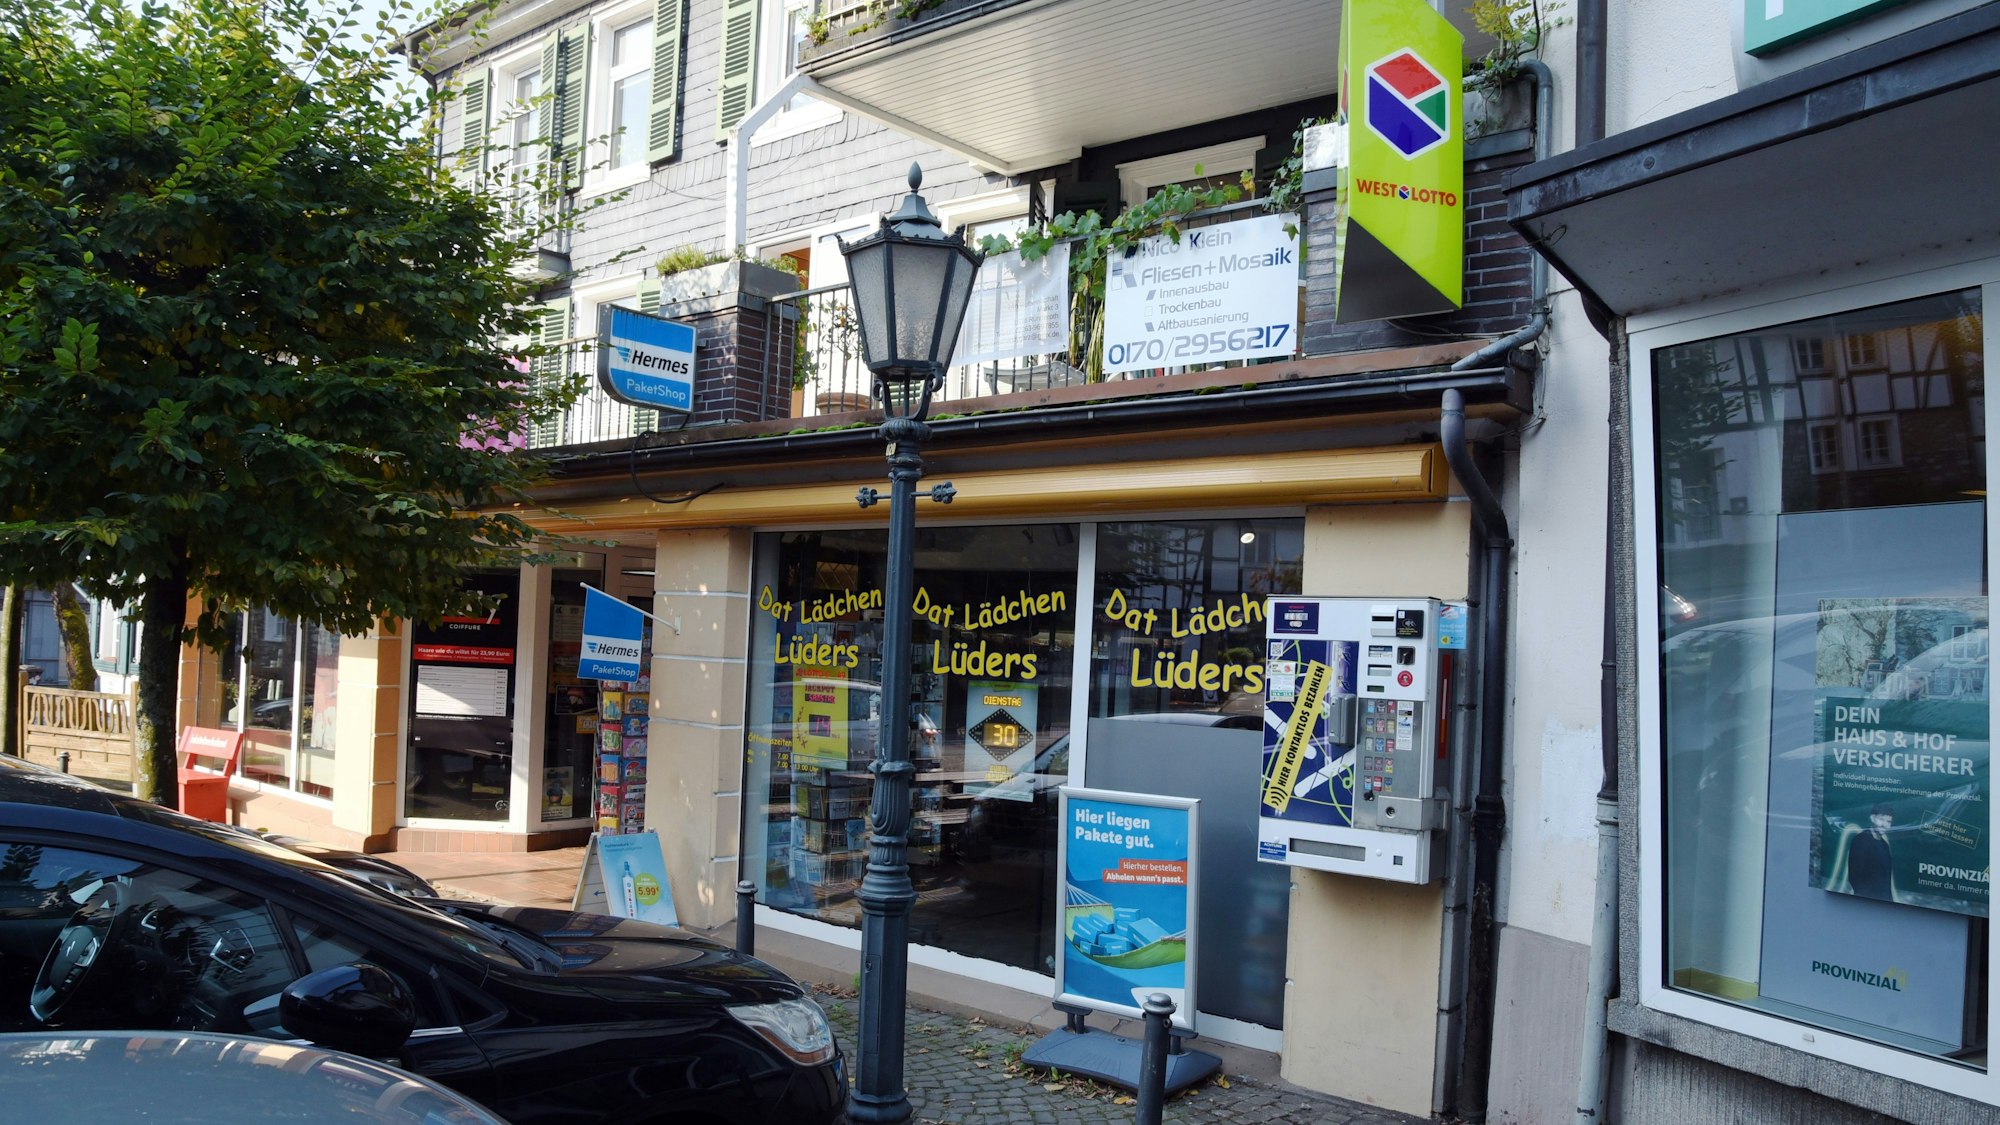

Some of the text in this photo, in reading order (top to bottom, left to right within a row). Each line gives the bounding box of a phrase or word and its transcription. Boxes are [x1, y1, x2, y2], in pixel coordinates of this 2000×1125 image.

[1356, 178, 1457, 207] WEST LOTTO
[1142, 231, 1232, 258] Nico Klein
[1159, 281, 1229, 299] Innenausbau
[1159, 298, 1222, 315] Trockenbau
[1157, 311, 1249, 331] Altbausanierung
[1108, 323, 1290, 366] 0170/2956217
[631, 350, 689, 375] Hermes
[626, 378, 686, 402] PaketShop
[758, 584, 882, 624] Dat Lädchen
[912, 586, 1066, 630] Dat Lädchen
[1104, 588, 1158, 636] Dat
[597, 643, 639, 657] Hermes
[774, 632, 859, 668] Lüders
[932, 639, 1038, 680] Lüders
[592, 664, 636, 677] PaketShop
[1130, 648, 1264, 694] Lüders
[983, 695, 1022, 707] DIENSTAG
[1277, 665, 1325, 787] HIER KONTAKTLOS BEZAHLEN
[1835, 705, 1880, 724] DEIN
[748, 732, 793, 747] Öffnungszeiten
[993, 724, 1016, 747] 30
[1834, 727, 1957, 752] HAUS & HOF
[1833, 748, 1975, 777] VERSICHERER
[1833, 772, 1901, 785] Individuell anpassbar:
[1845, 782, 1932, 797] Wohngebäudeversicherung
[1933, 790, 1945, 798] der
[1946, 791, 1983, 802] Provinzial.
[1075, 808, 1150, 831] Hier liegen
[1953, 824, 1967, 834] hier
[1075, 826, 1154, 849] Pakete gut.
[1924, 822, 1974, 845] beraten lassen
[1106, 872, 1184, 885] Abholen wann's passt.
[1123, 861, 1184, 873] Hierher bestellen.
[1918, 878, 1942, 888] Immer
[1944, 881, 1955, 890] da.
[1957, 884, 1983, 894] Immer
[1812, 960, 1901, 992] PROVINZIAL
